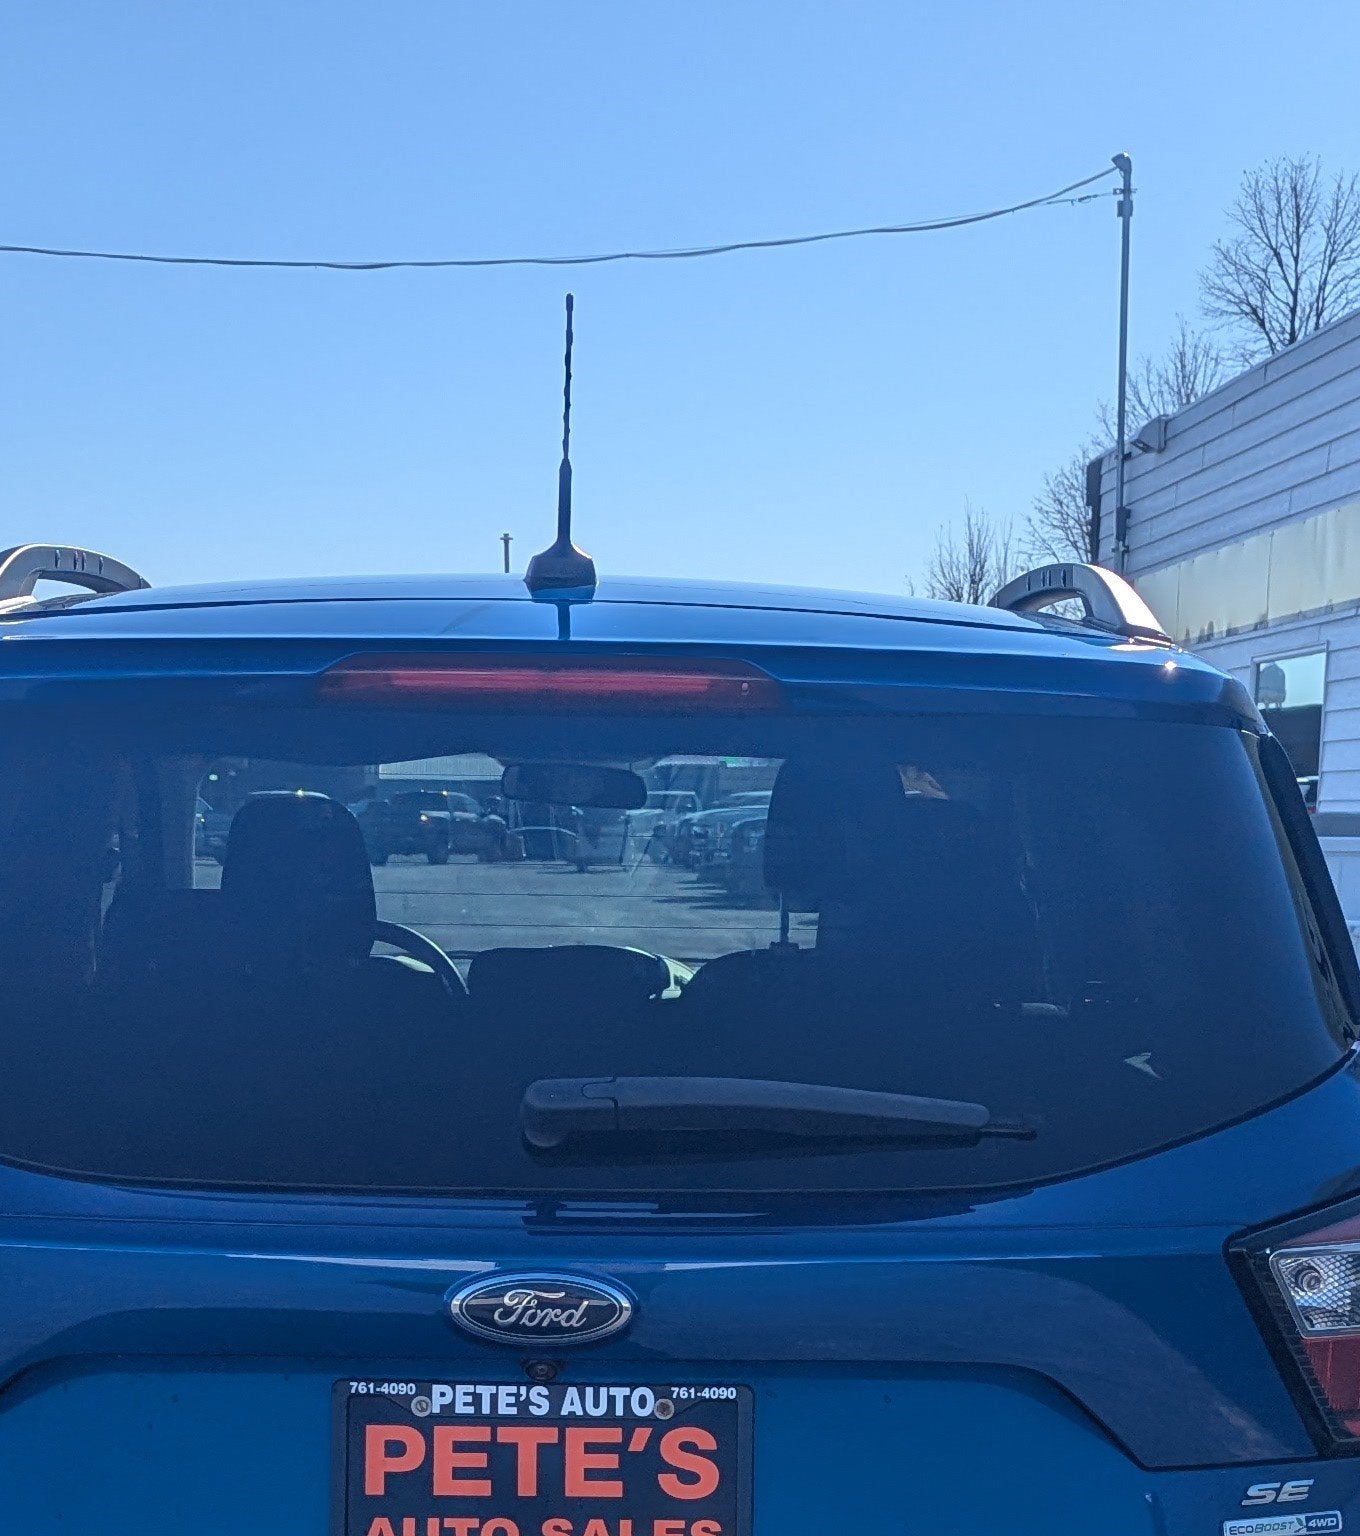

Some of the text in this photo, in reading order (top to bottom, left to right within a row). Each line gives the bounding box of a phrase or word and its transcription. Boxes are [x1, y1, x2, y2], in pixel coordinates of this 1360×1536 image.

[493, 1288, 590, 1329] Ford
[349, 1381, 417, 1396] 761-4090
[430, 1384, 656, 1417] PETE'S AUTO
[670, 1386, 737, 1400] 761-4090
[364, 1424, 721, 1500] PETE'S
[1241, 1478, 1315, 1506] SE
[1307, 1517, 1338, 1529] 4WD
